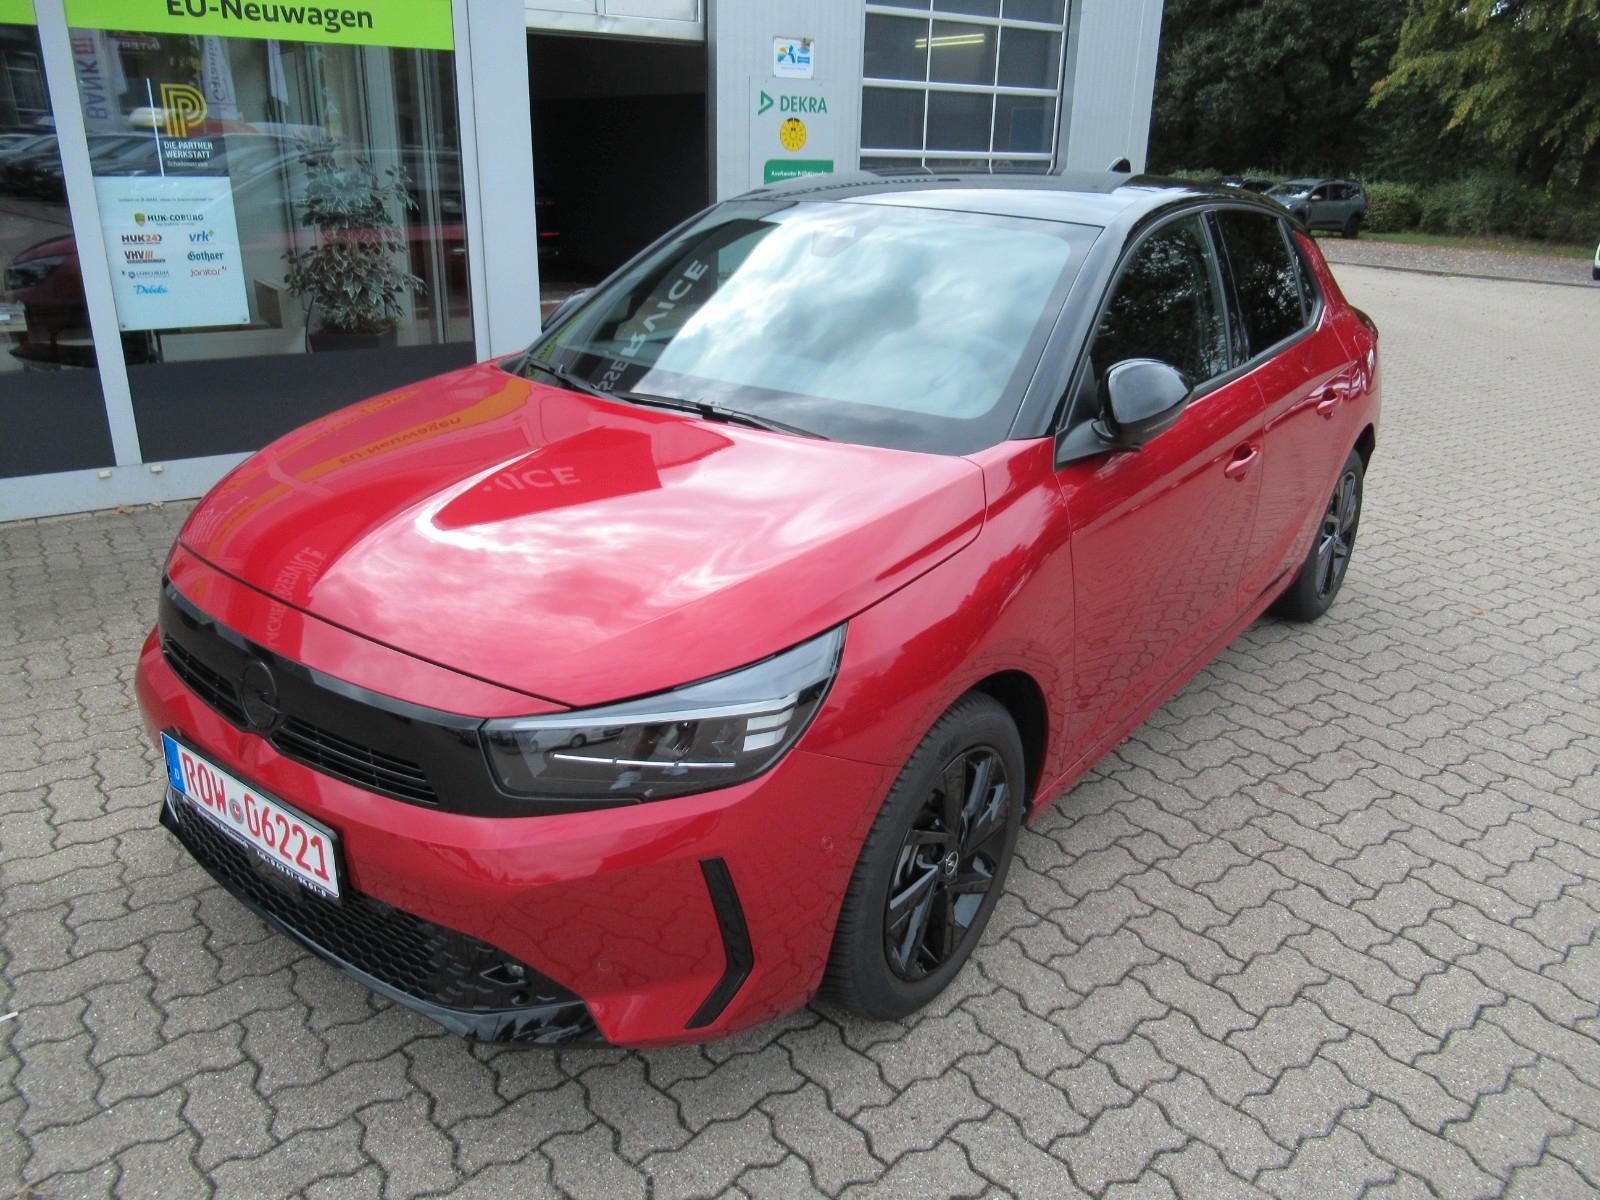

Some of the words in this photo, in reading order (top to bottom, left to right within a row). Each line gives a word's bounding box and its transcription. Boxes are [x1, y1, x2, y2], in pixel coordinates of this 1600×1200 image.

[167, 0, 373, 33] EU-Neuwagen
[780, 95, 828, 113] DEKRA
[164, 141, 177, 150] DIE
[178, 142, 213, 151] PARTNER
[166, 150, 210, 160] WERKSTATT
[189, 231, 209, 242] vrk
[124, 250, 144, 260] VHV
[187, 251, 224, 262] Gothaer
[181, 751, 228, 817] ROW
